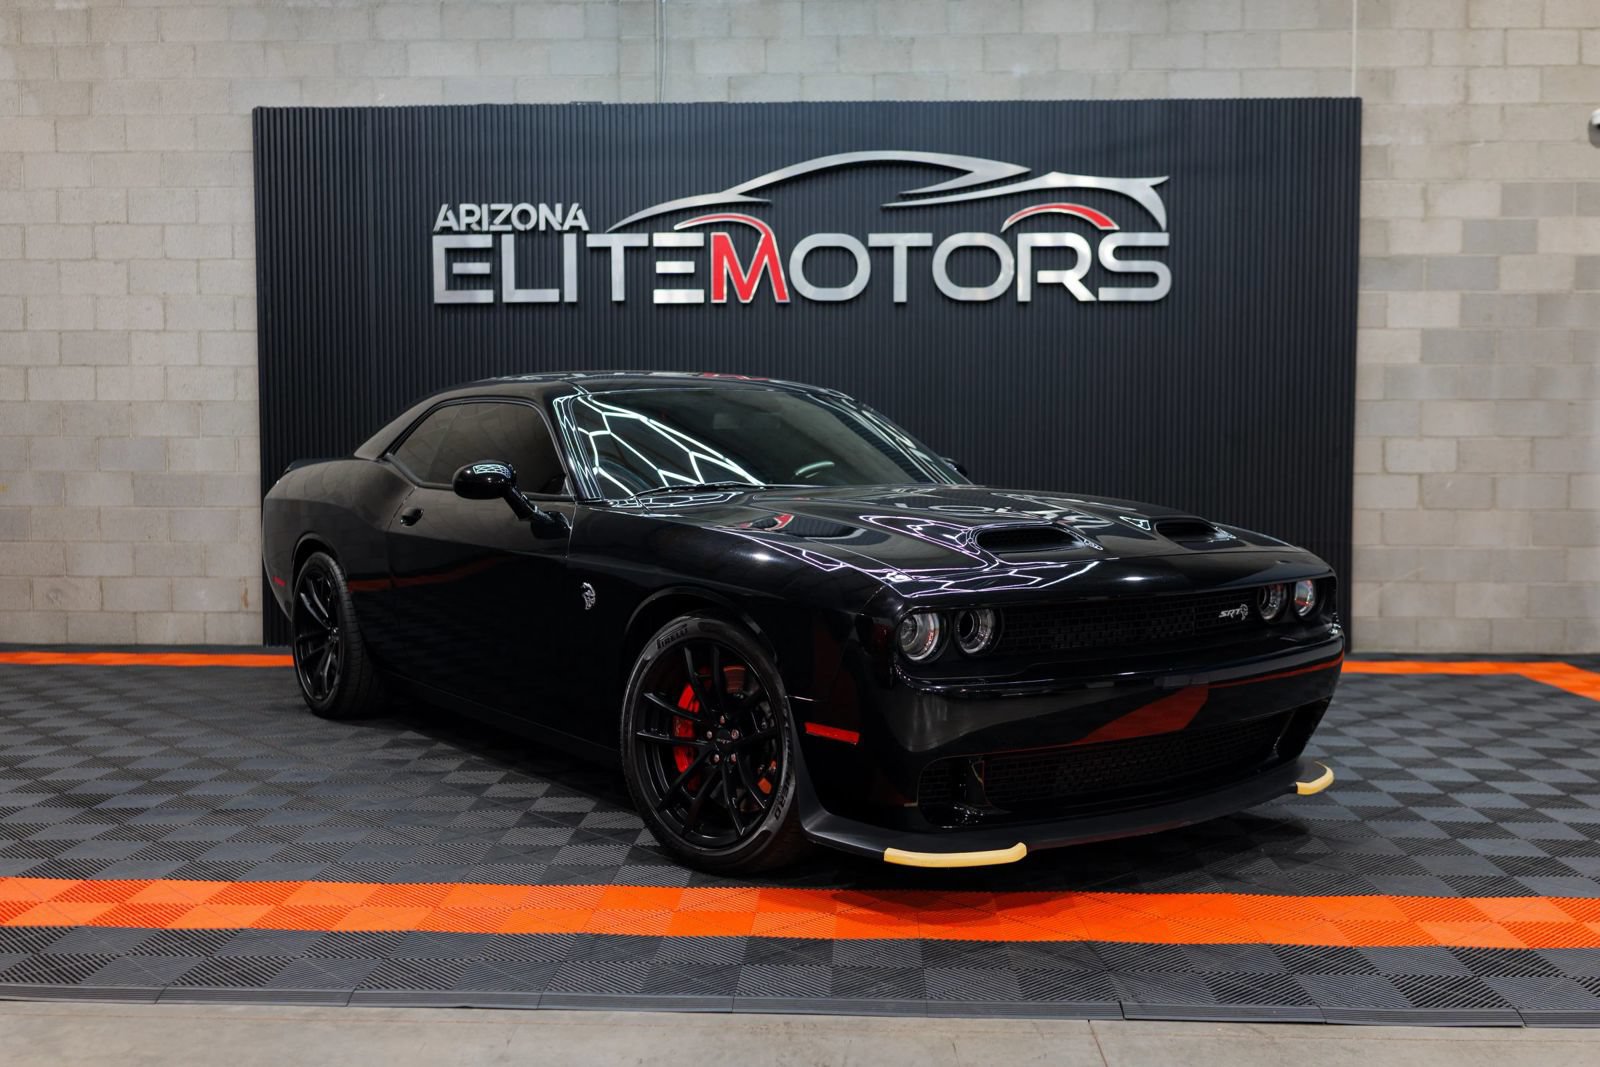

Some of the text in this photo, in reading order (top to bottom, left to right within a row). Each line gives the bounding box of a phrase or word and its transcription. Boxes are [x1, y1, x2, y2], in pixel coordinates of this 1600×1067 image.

[433, 203, 589, 232] ARIZONA
[1219, 608, 1242, 618] SRT
[656, 624, 688, 649] PIRELLI
